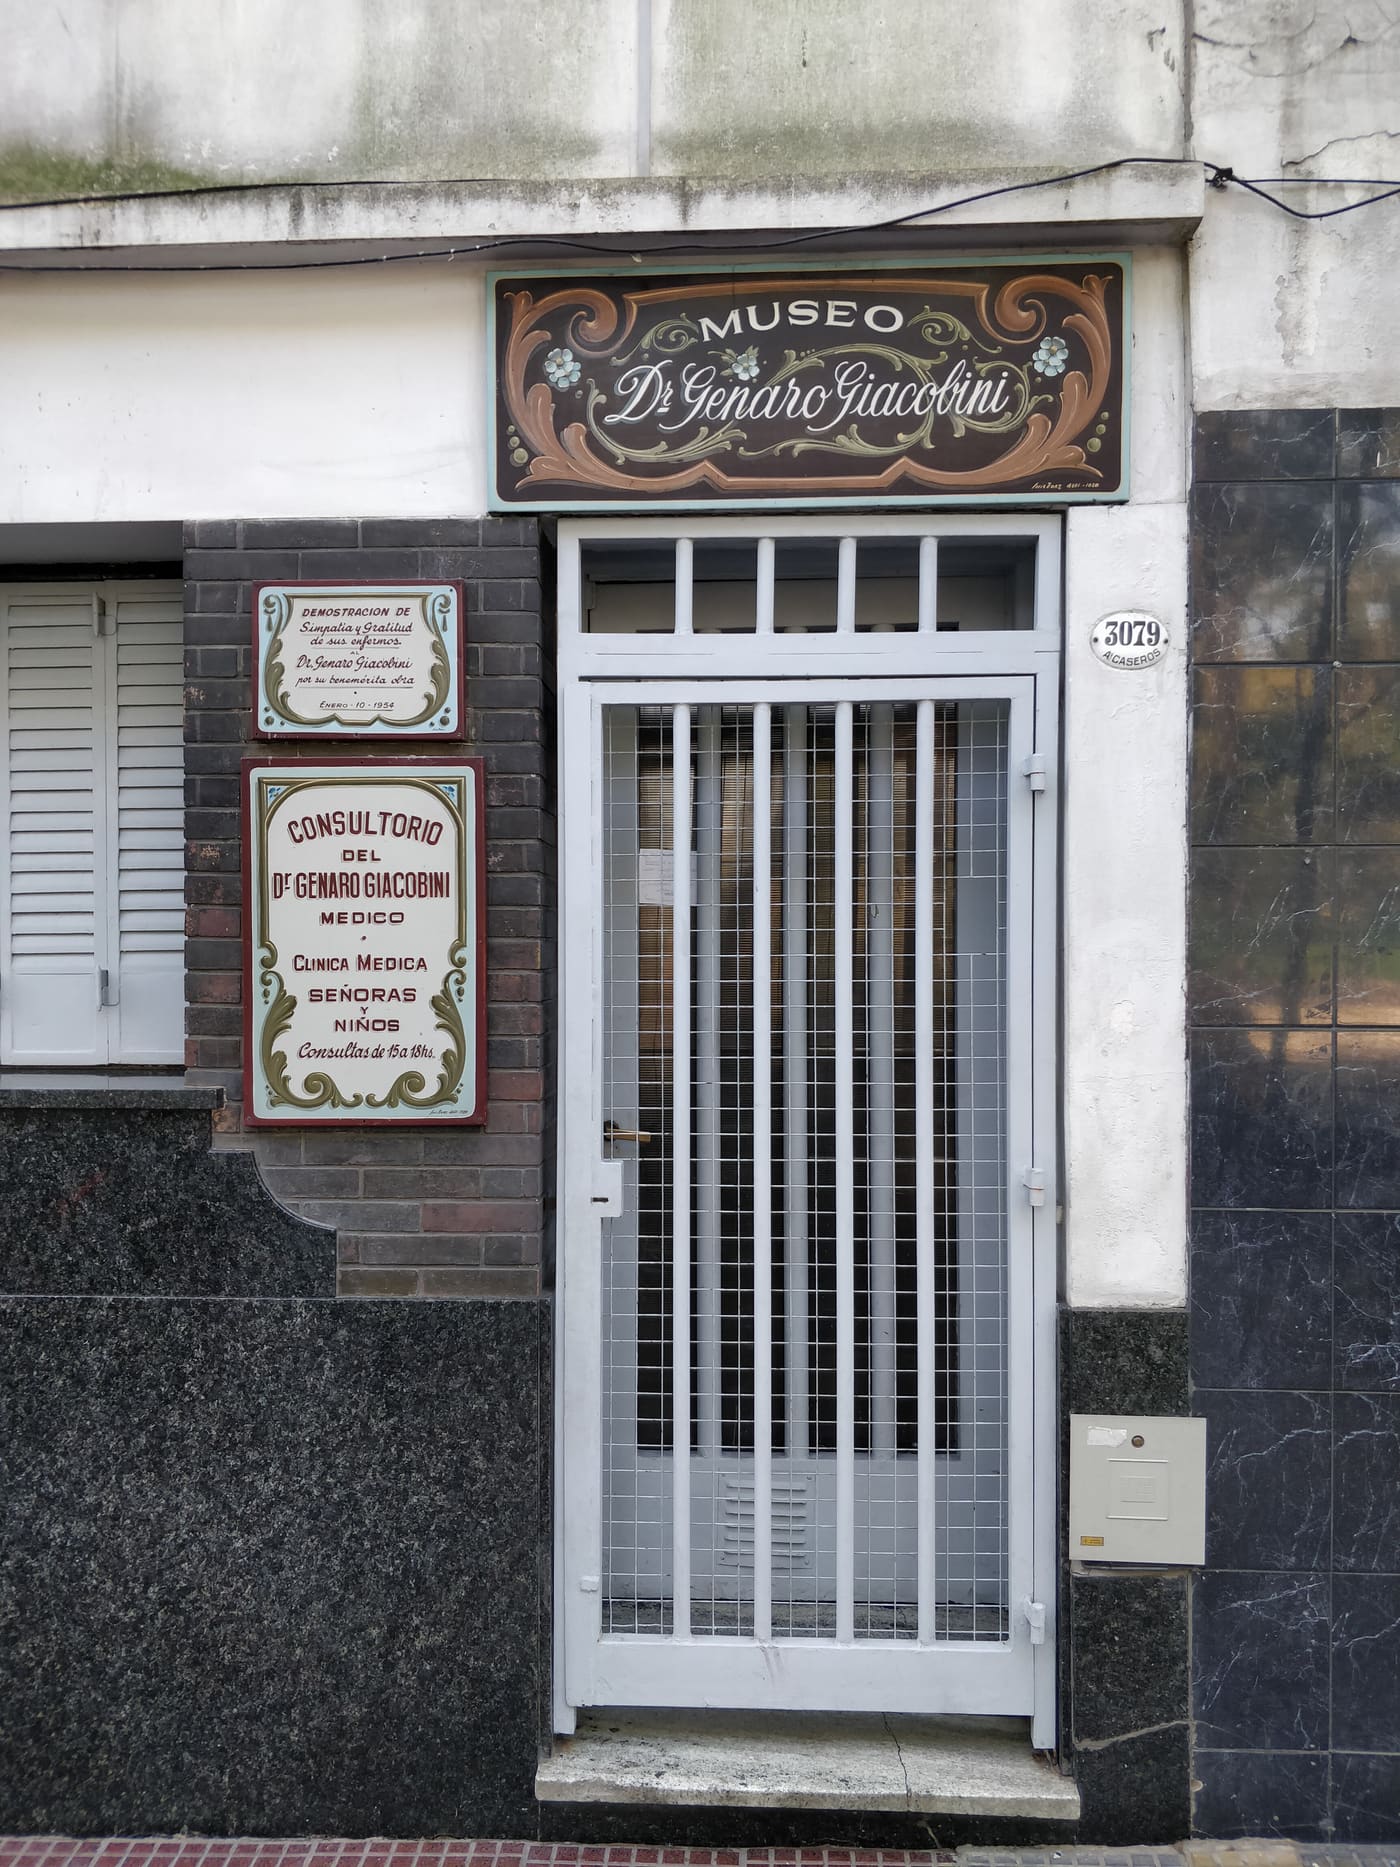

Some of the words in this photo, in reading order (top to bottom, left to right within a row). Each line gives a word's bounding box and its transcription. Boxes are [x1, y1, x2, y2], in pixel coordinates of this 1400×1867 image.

[698, 299, 904, 343] MUSEO
[658, 362, 833, 431] Genaro
[806, 359, 1009, 432] Giacobini
[302, 608, 389, 617] DEMOSTRACION
[395, 607, 411, 616] DE
[355, 626, 362, 636] y
[362, 621, 413, 634] Gratitud
[1104, 620, 1161, 646] 3079
[310, 635, 324, 645] de
[351, 635, 402, 650] enfermos.
[296, 654, 314, 669] Dr.
[312, 655, 353, 671] Genaro
[353, 656, 413, 671] Giacobini
[295, 676, 312, 687] por
[390, 674, 415, 685] obra
[355, 701, 366, 709] 10
[287, 811, 444, 846] CONSULTORIO
[342, 850, 381, 862] DEL
[295, 872, 360, 899] GENARO
[364, 872, 450, 898] GIACOBINI
[321, 912, 405, 924] MEDICO
[293, 954, 349, 971] CLINICA
[357, 954, 428, 971] MEDICA
[309, 984, 417, 1002] SEÑORAS
[360, 1007, 368, 1015] Y
[335, 1017, 400, 1032] NIÑOS
[298, 1042, 370, 1059] Consultas
[371, 1044, 385, 1059] de
